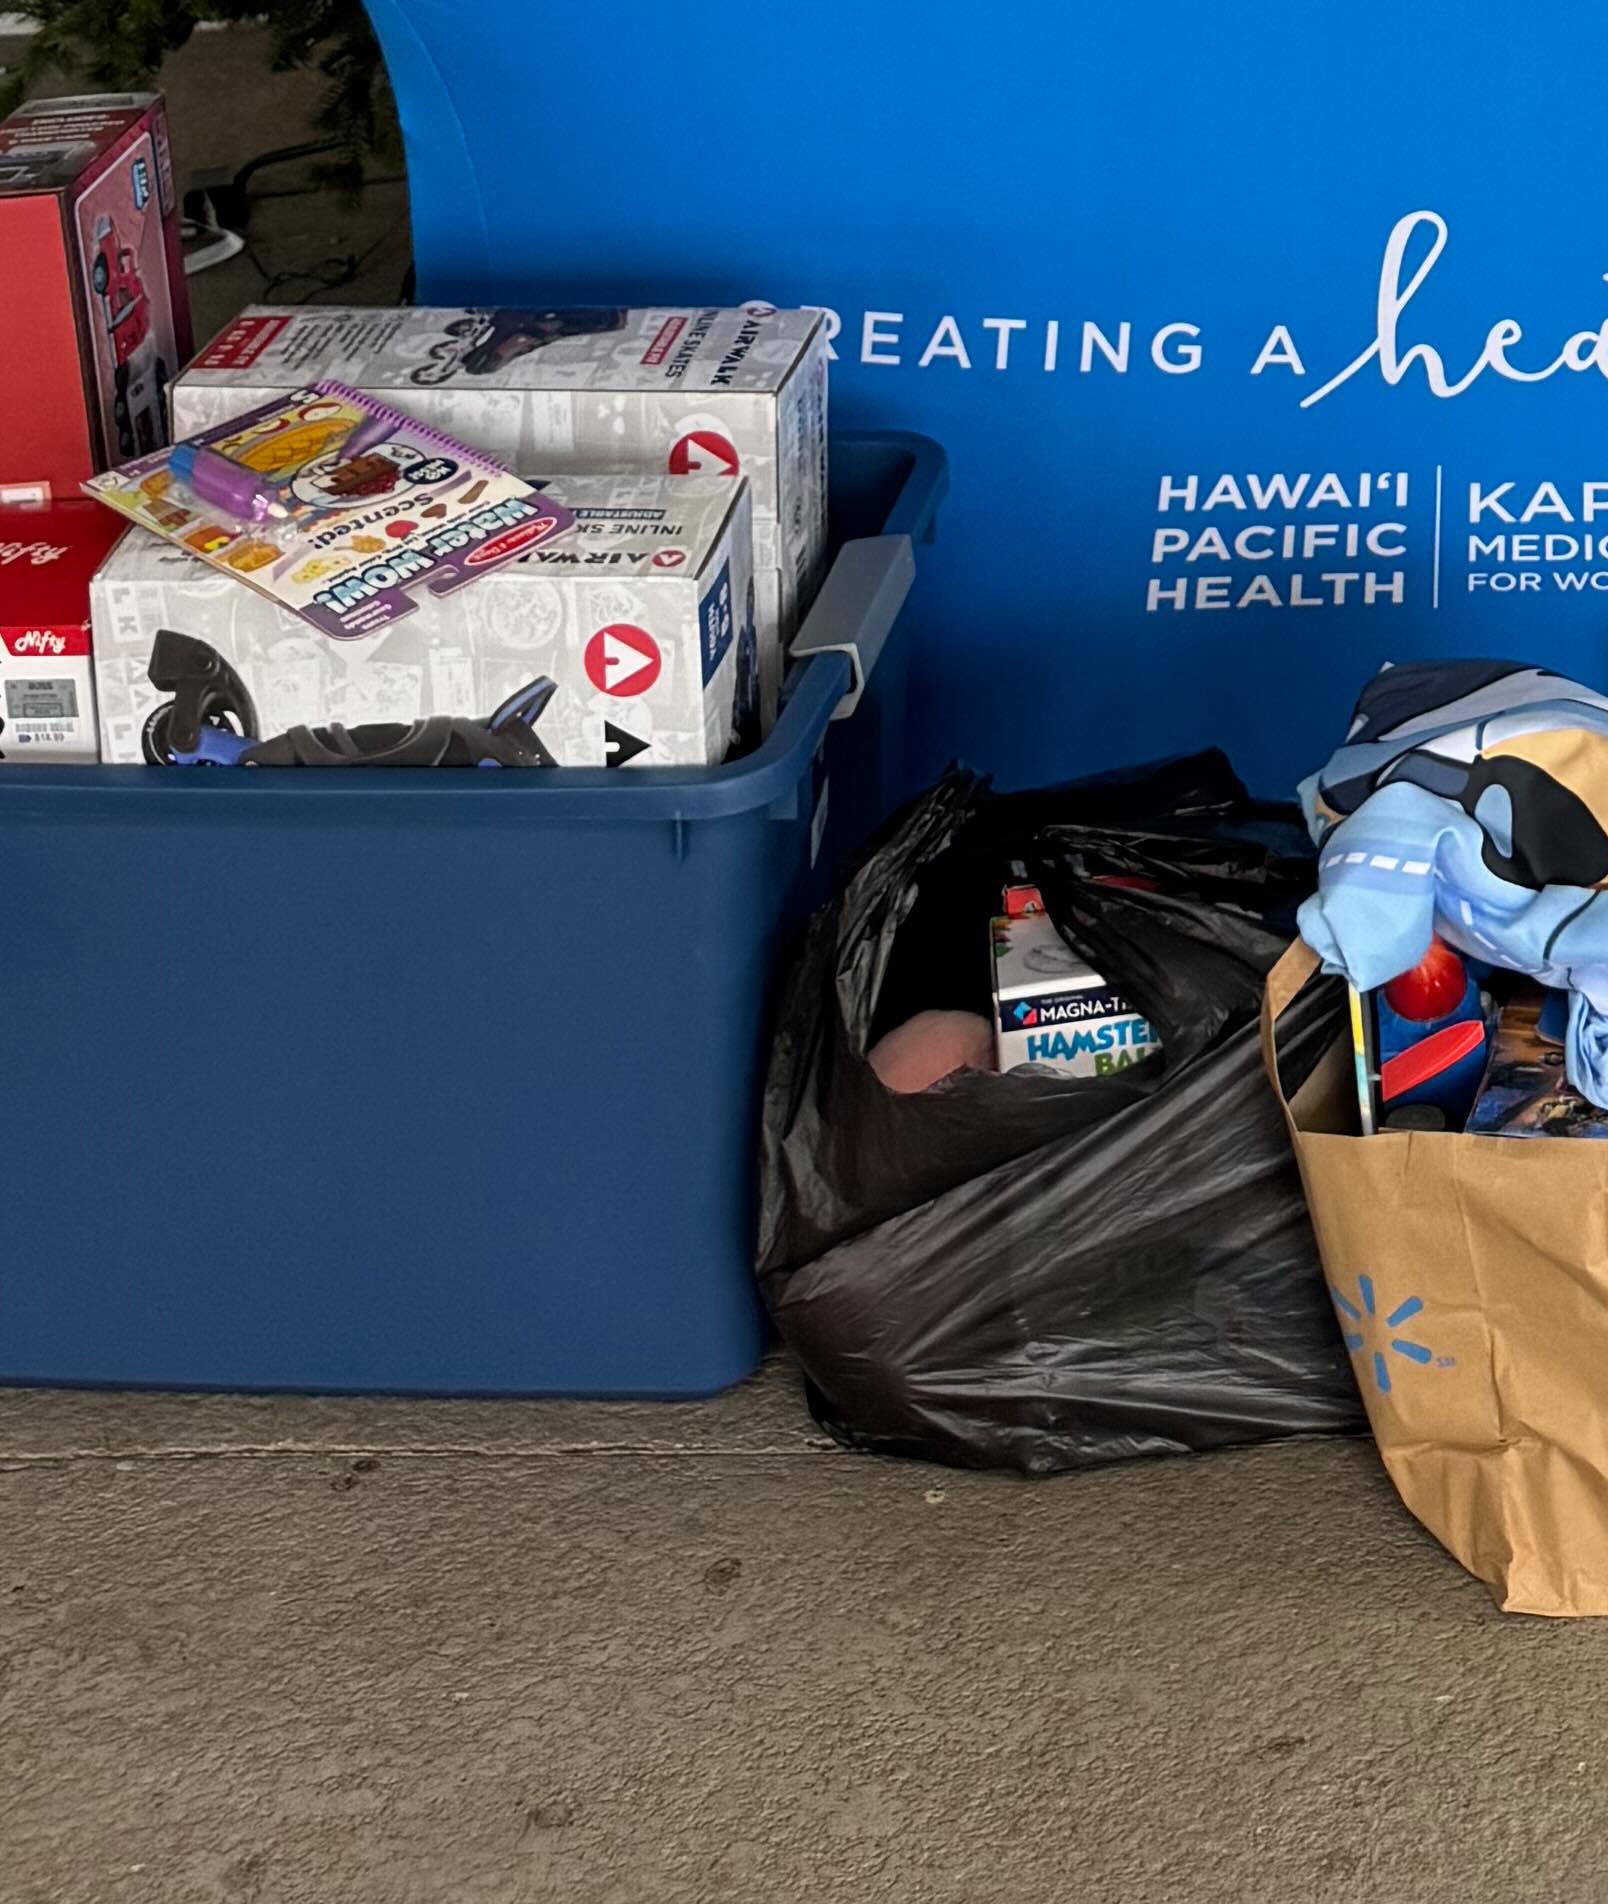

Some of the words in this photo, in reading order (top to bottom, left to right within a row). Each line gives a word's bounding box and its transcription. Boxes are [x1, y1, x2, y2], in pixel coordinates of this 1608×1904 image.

[665, 339, 702, 379] SKATES
[710, 319, 763, 386] AIRWALK
[800, 304, 1203, 374] REATING
[1250, 324, 1306, 375] A
[307, 493, 433, 549] Scented!
[435, 497, 537, 557] Water
[609, 524, 683, 536] INLINE
[1151, 522, 1408, 563] PACIFIC
[313, 546, 436, 612] WOW!
[1145, 571, 1404, 612] HEALTH
[1467, 571, 1542, 593] FOR
[14, 629, 67, 654] Nifty
[1040, 996, 1130, 1023] MAGNA-T
